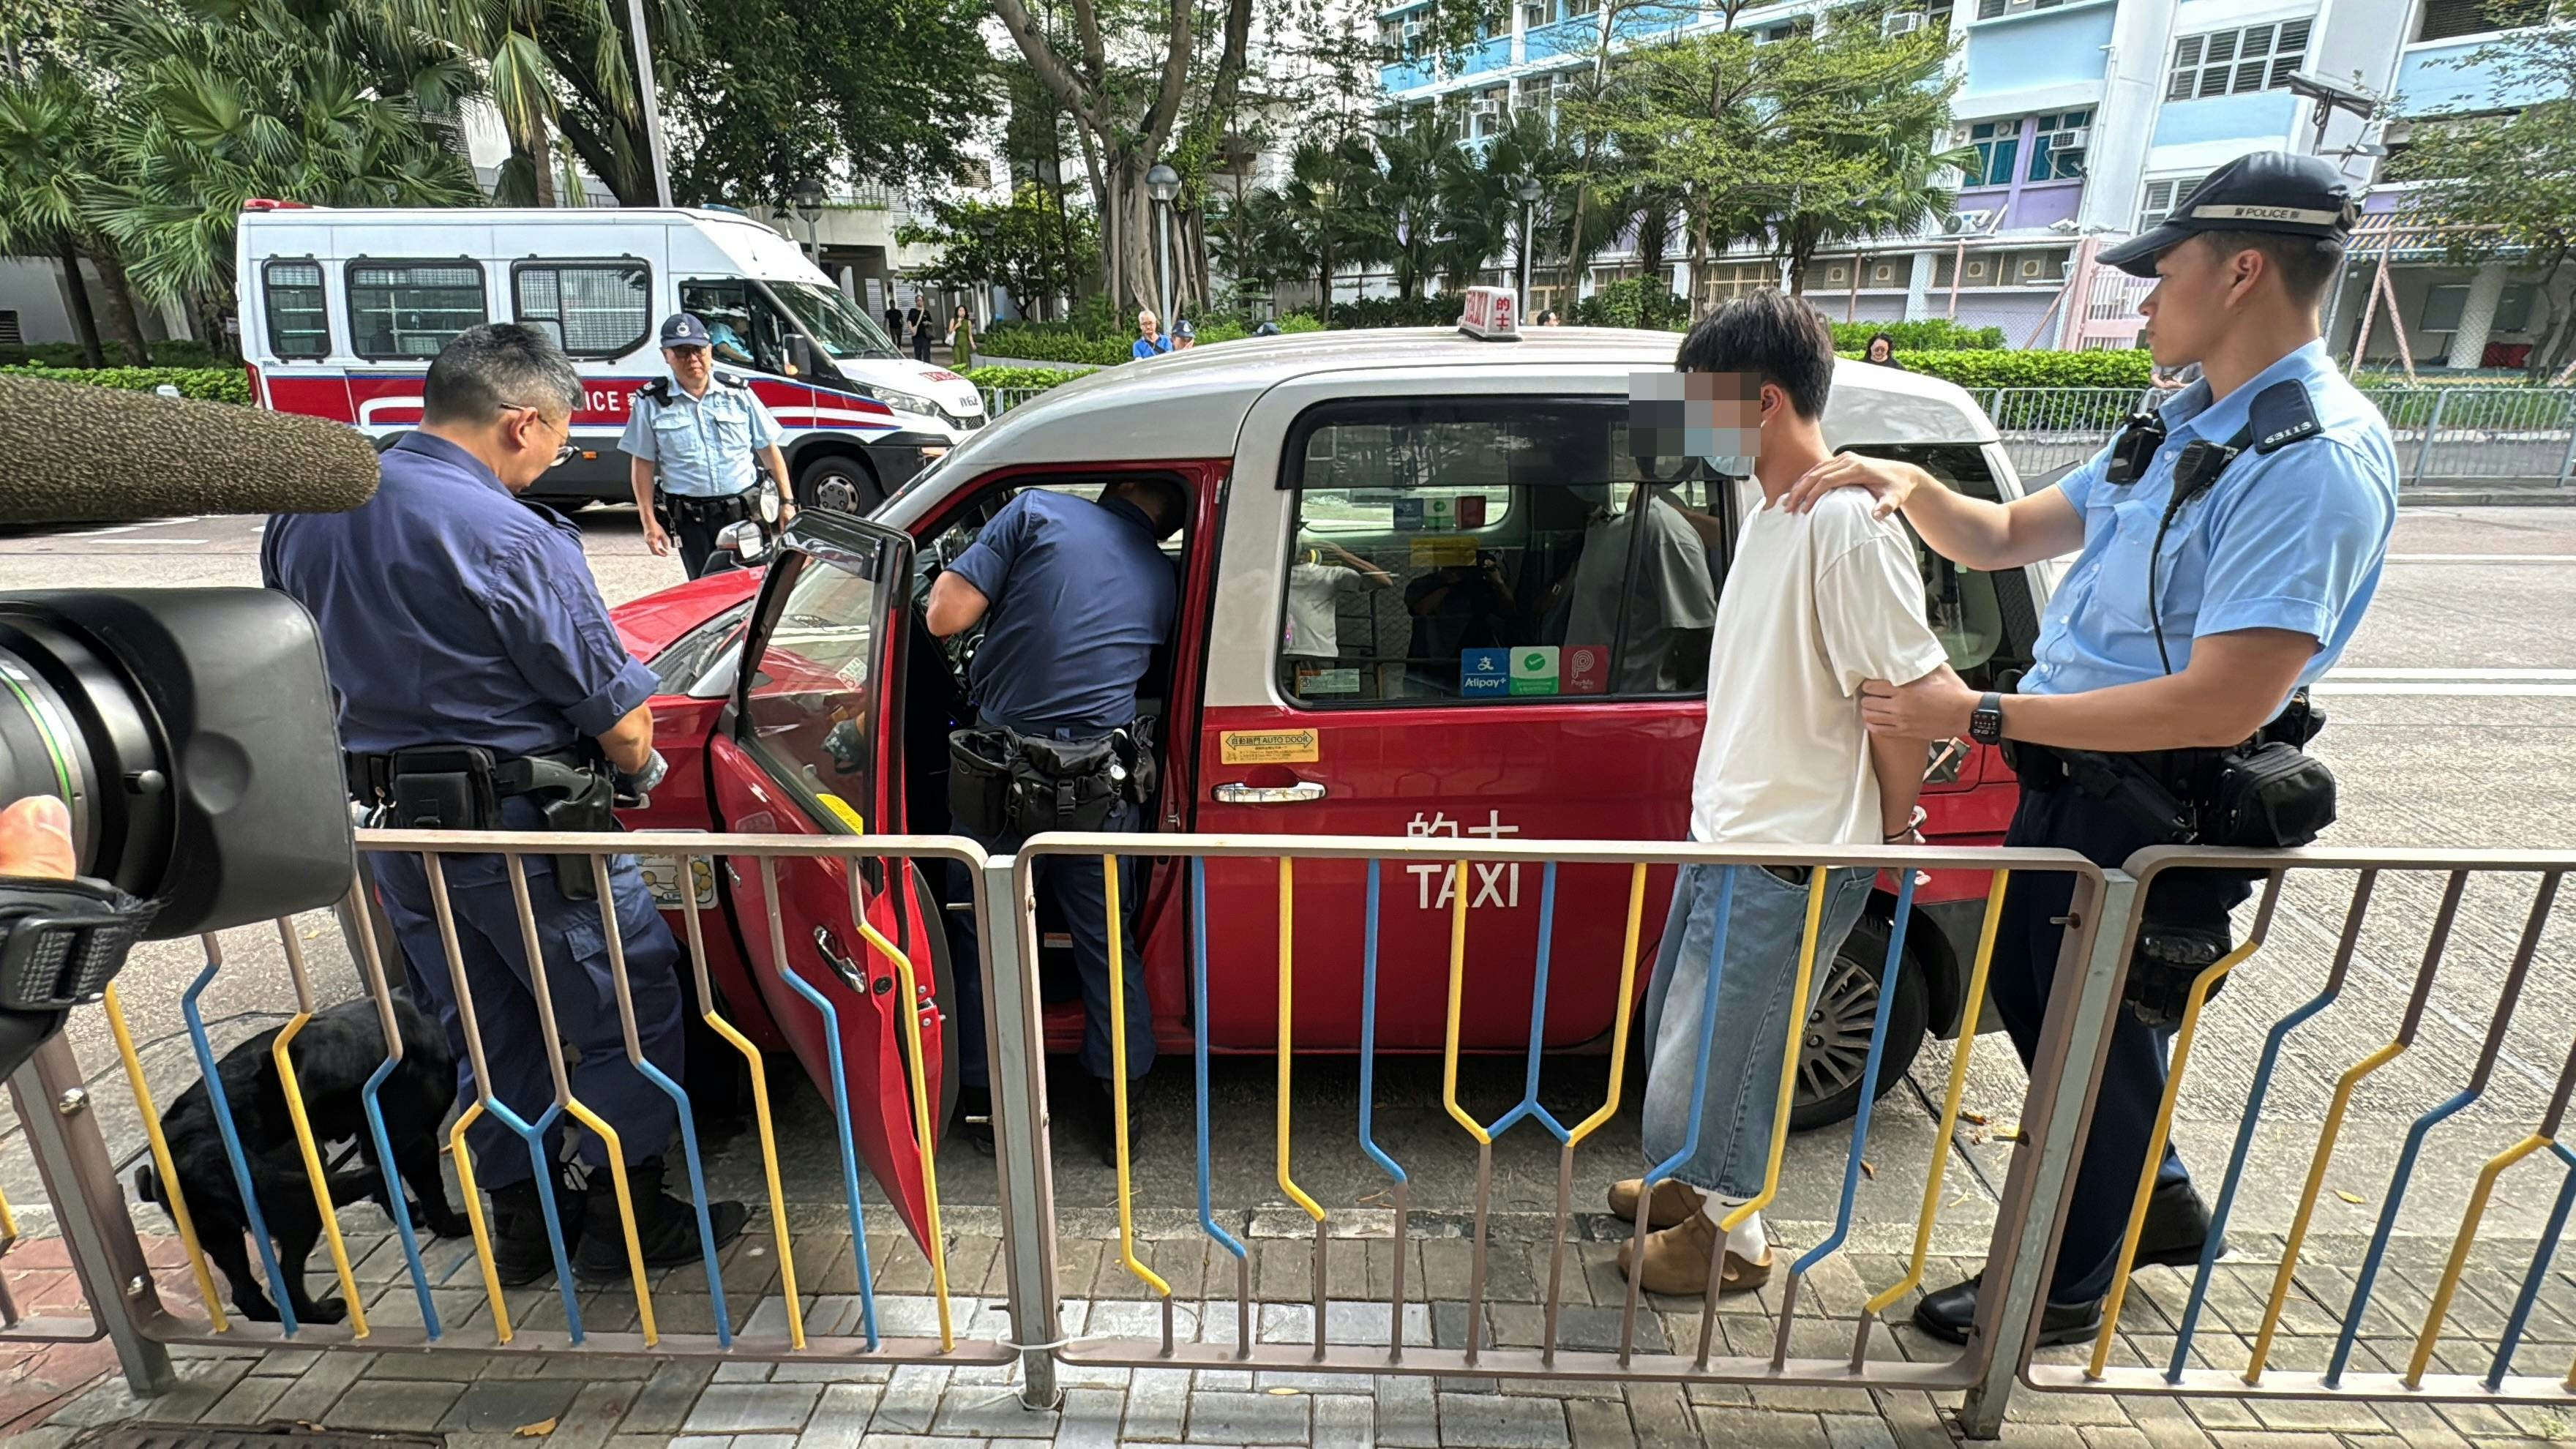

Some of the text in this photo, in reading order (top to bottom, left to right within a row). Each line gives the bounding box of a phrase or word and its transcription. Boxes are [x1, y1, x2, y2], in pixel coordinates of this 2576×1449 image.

[2246, 208, 2290, 218] POLICE
[1495, 297, 1510, 327] 的士
[583, 391, 621, 411] ICE
[1407, 863, 1519, 909] TAXI
